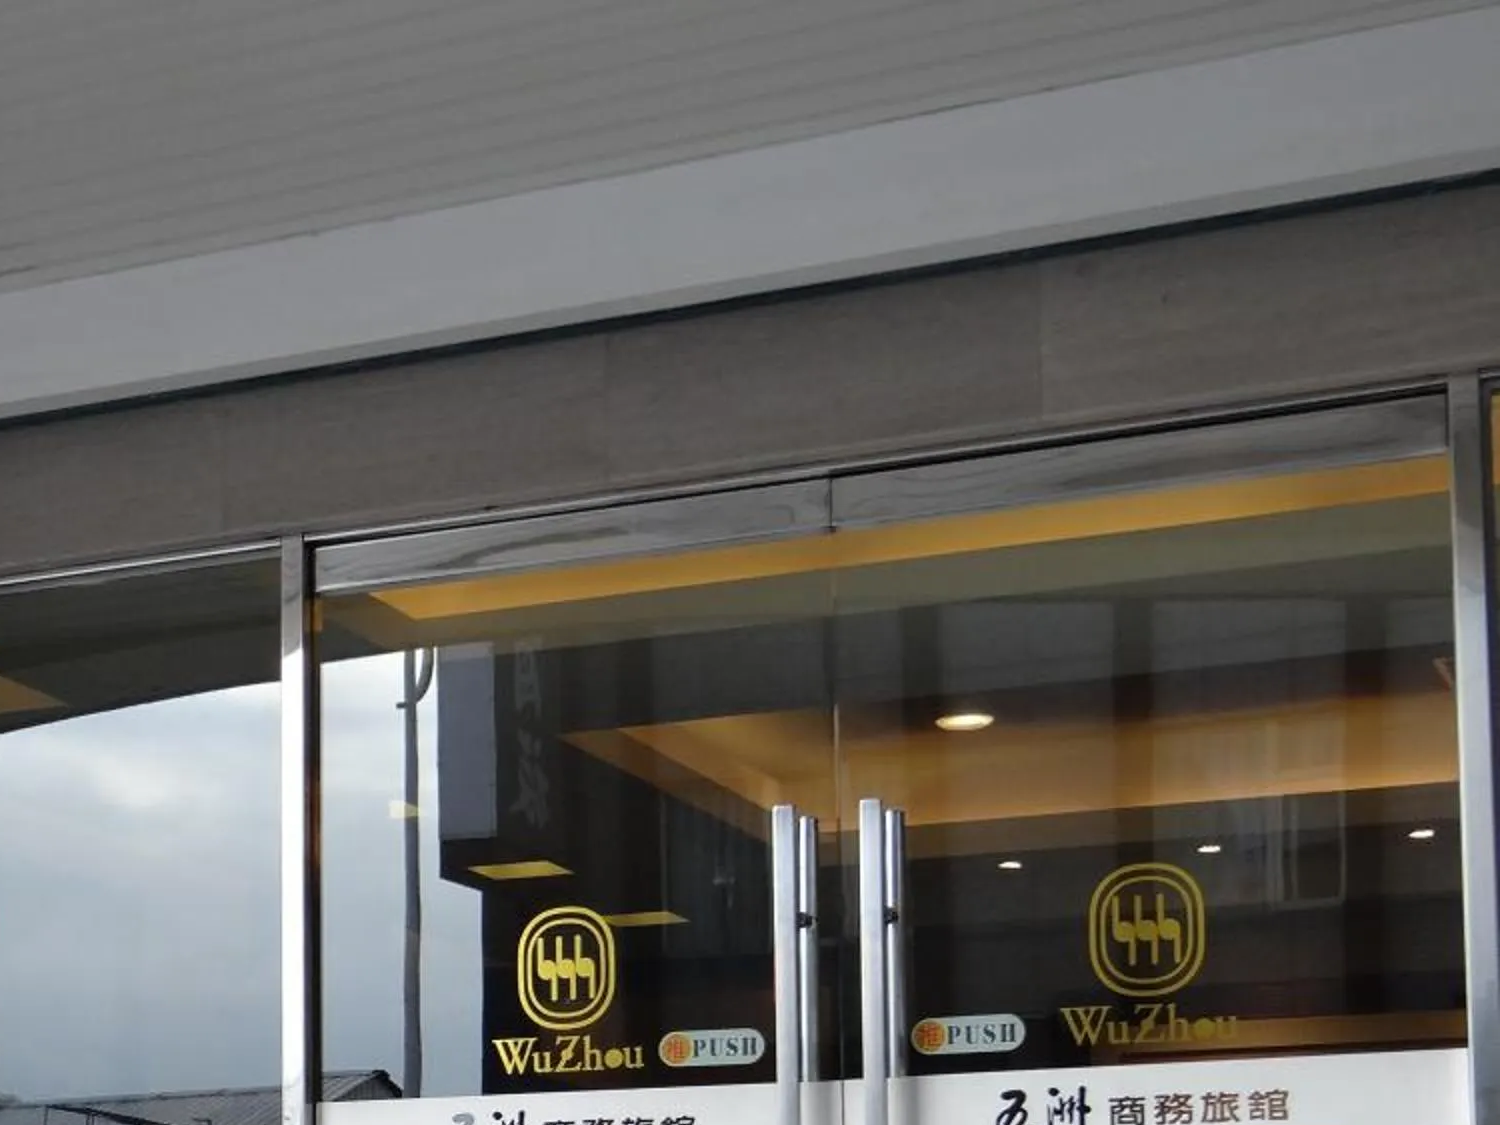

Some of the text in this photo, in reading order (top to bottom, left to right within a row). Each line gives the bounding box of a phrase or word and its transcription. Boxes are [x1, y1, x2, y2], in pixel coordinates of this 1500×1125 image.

[947, 1023, 1016, 1045] PUSH
[1059, 1003, 1238, 1047] WuZhou
[491, 1034, 645, 1075] WuZhou
[693, 1036, 758, 1058] PUSH
